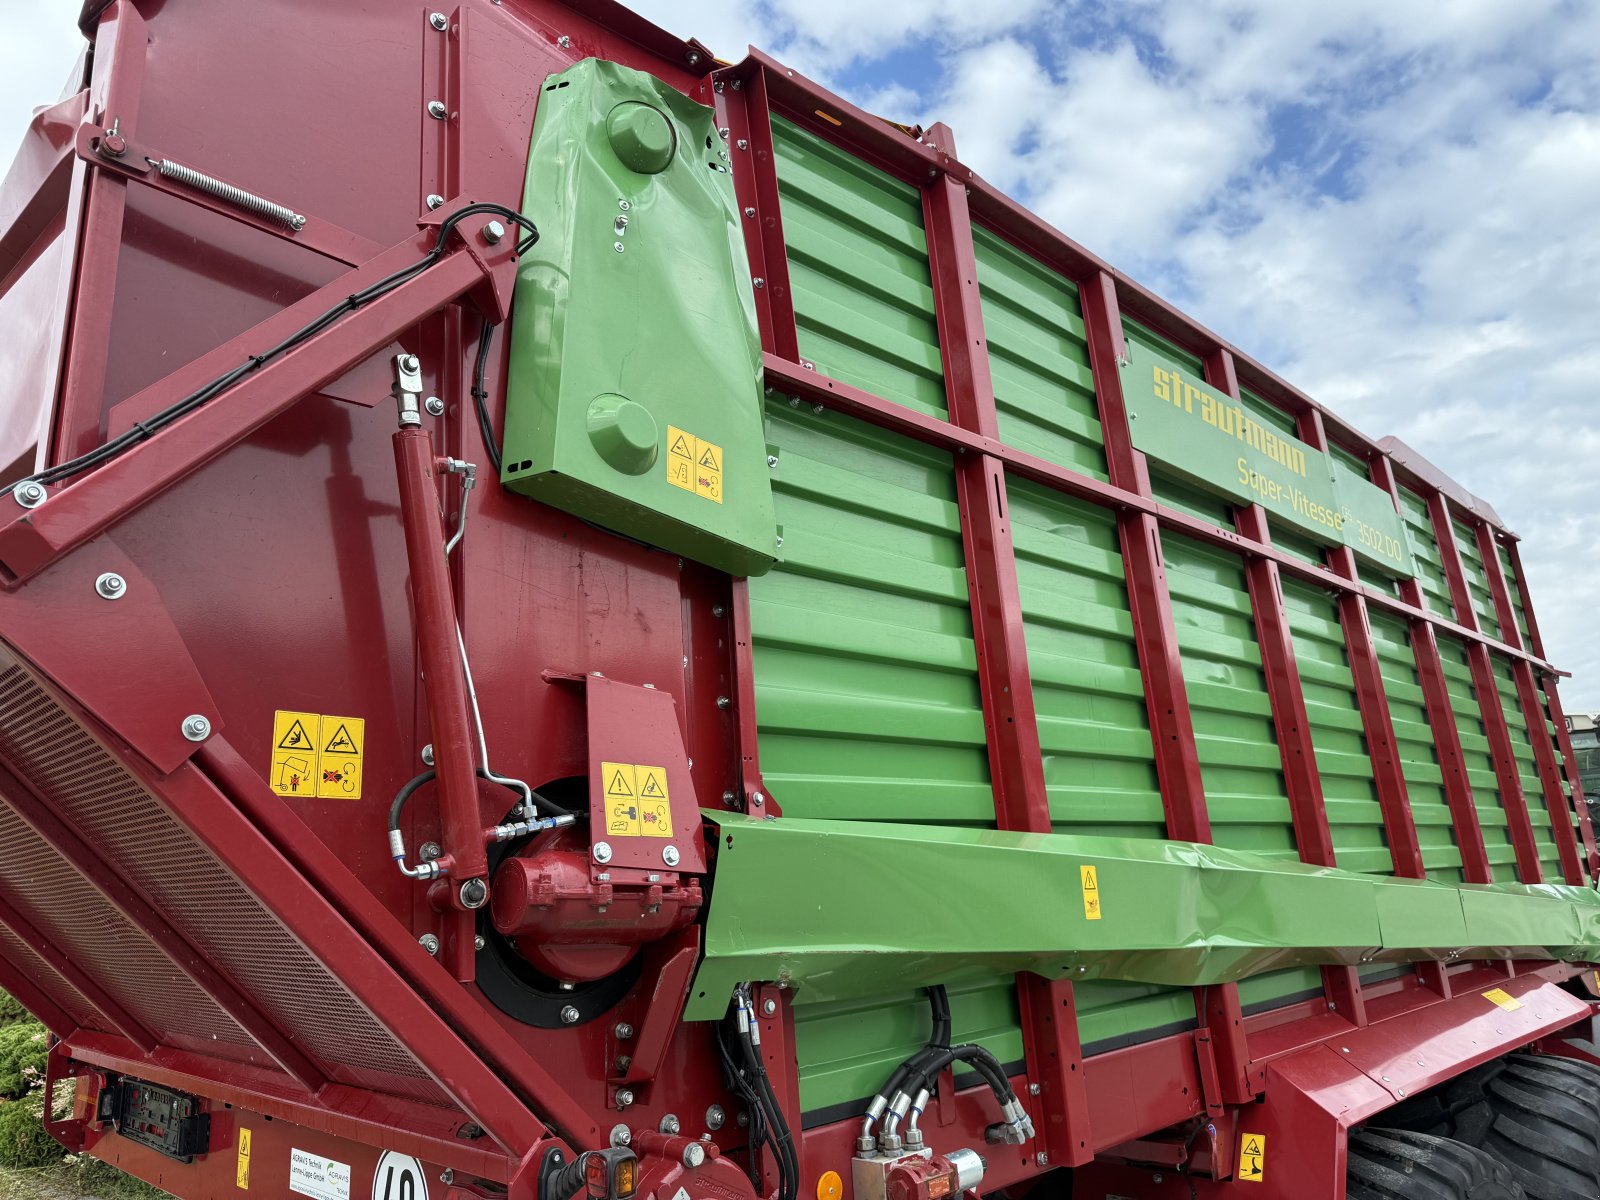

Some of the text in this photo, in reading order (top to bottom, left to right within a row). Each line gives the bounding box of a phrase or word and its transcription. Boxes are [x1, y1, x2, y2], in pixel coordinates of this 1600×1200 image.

[1153, 365, 1306, 478] strautmann
[1237, 456, 1344, 532] Super-Vitesse
[1356, 519, 1403, 561] 3502 DO
[328, 1170, 349, 1183] AGRAVIS
